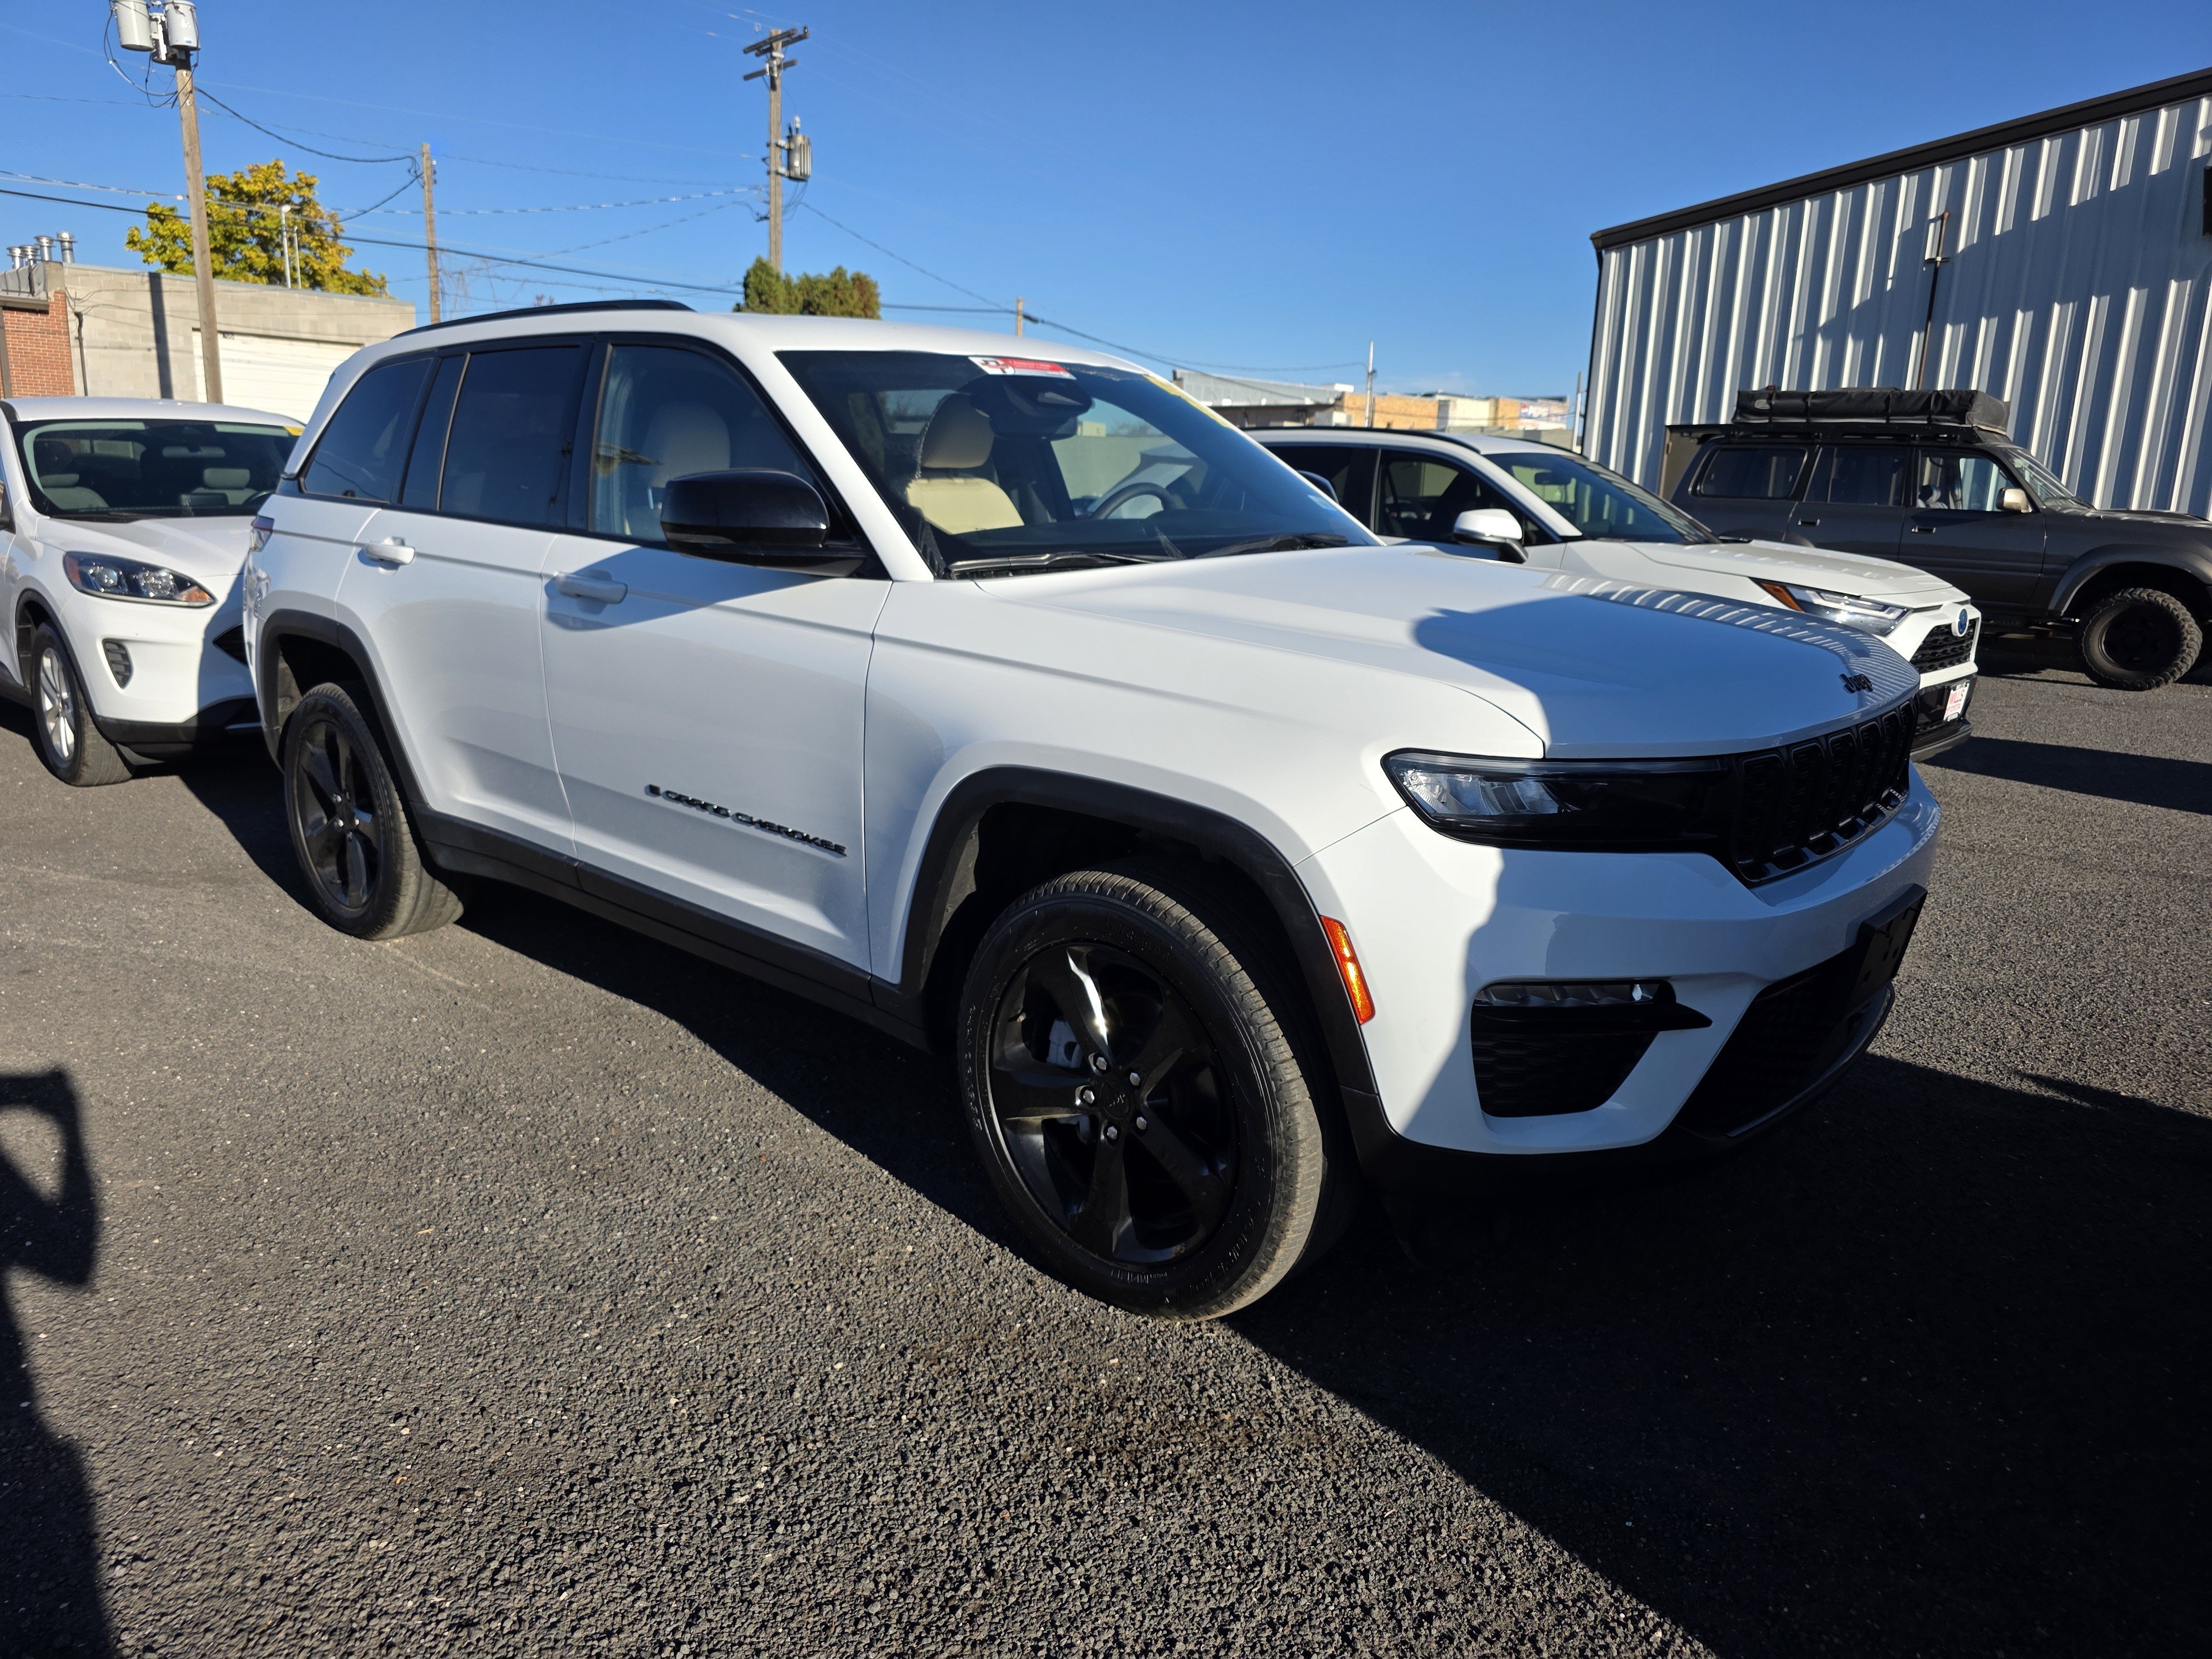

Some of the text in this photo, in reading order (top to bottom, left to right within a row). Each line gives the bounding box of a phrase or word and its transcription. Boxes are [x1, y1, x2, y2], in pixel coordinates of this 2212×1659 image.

[1839, 673, 1874, 694] Jeep
[665, 790, 847, 857] GRAND CHEROKEE
